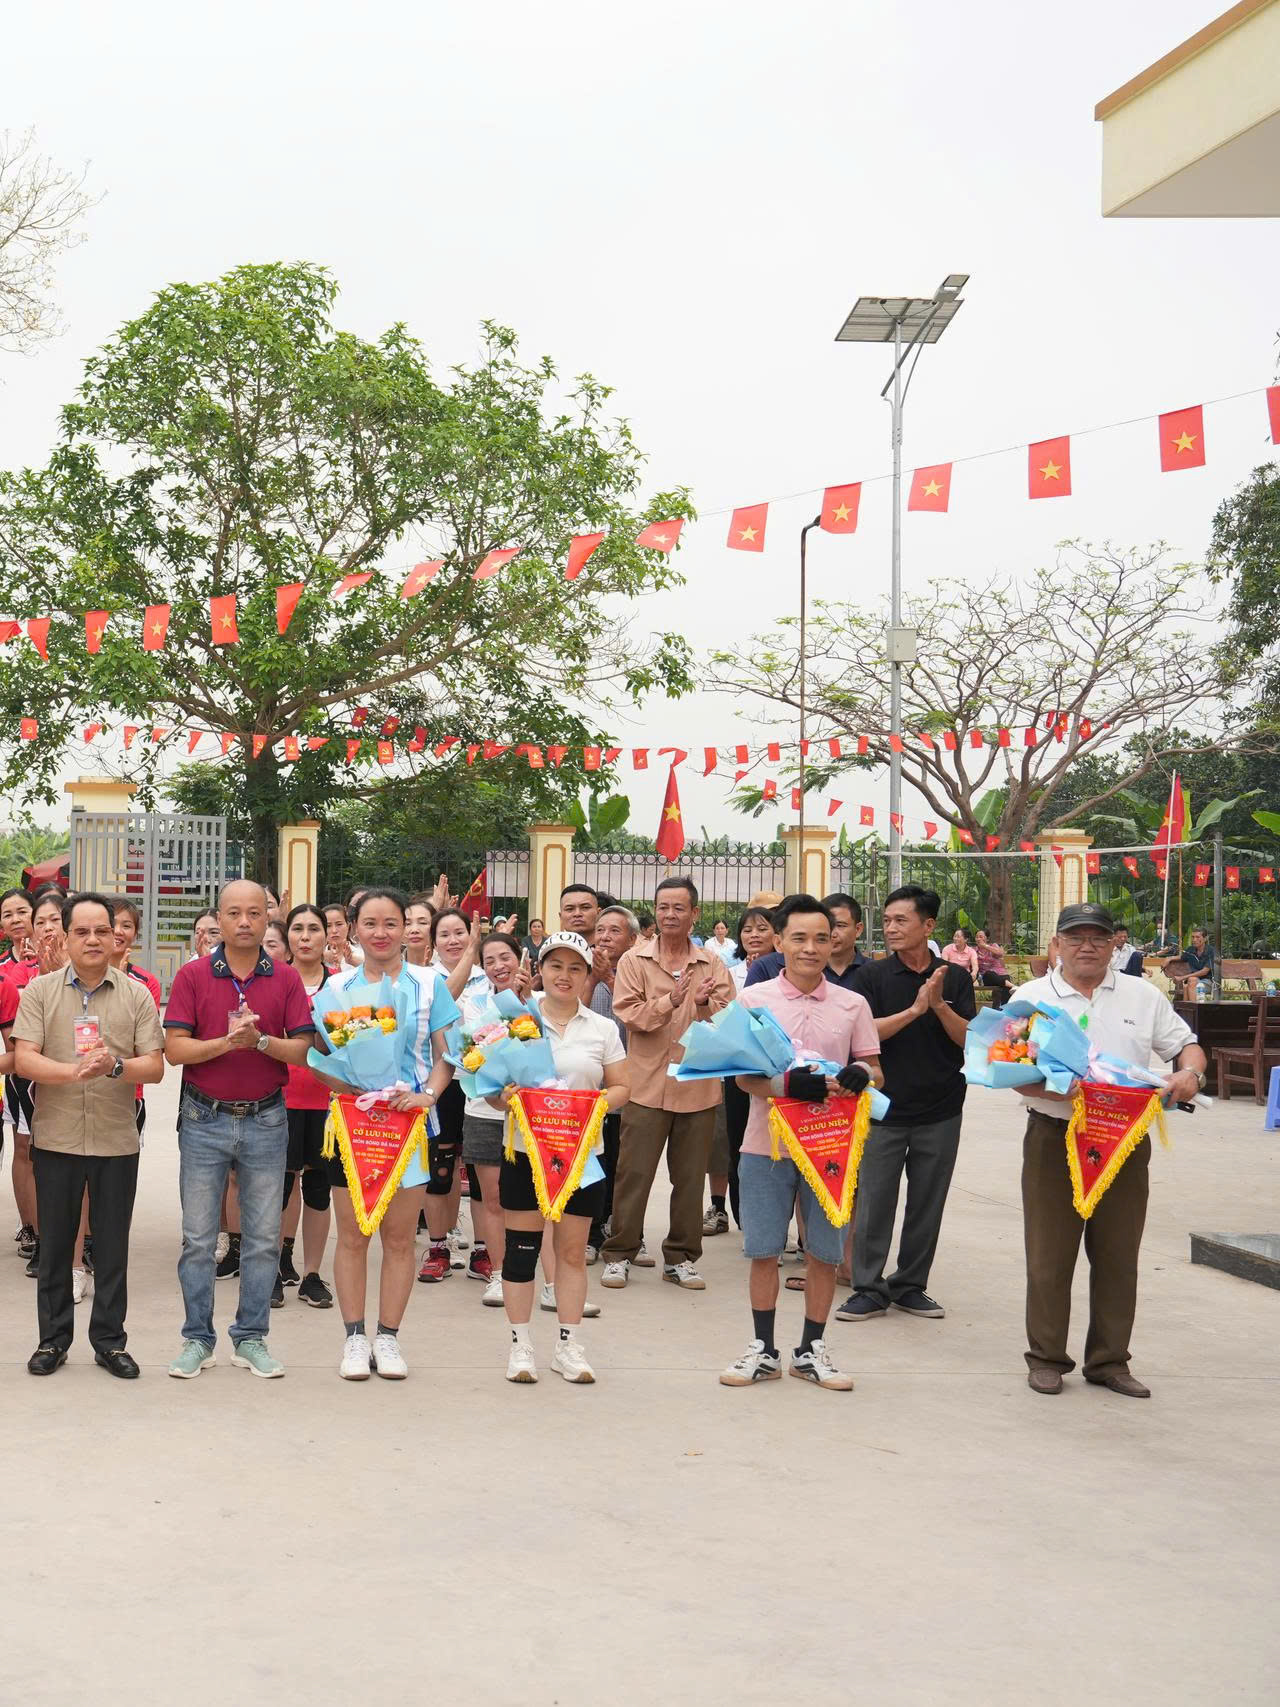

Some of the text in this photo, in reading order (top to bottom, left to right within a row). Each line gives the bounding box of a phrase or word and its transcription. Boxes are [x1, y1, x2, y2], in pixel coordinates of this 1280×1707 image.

[543, 1116, 559, 1125] LƯU
[560, 1118, 580, 1128] NIỆM
[810, 1121, 827, 1131] LƯU
[827, 1118, 849, 1127] NIỆM
[364, 1129, 381, 1137] LƯU
[381, 1131, 401, 1140] NIỆM
